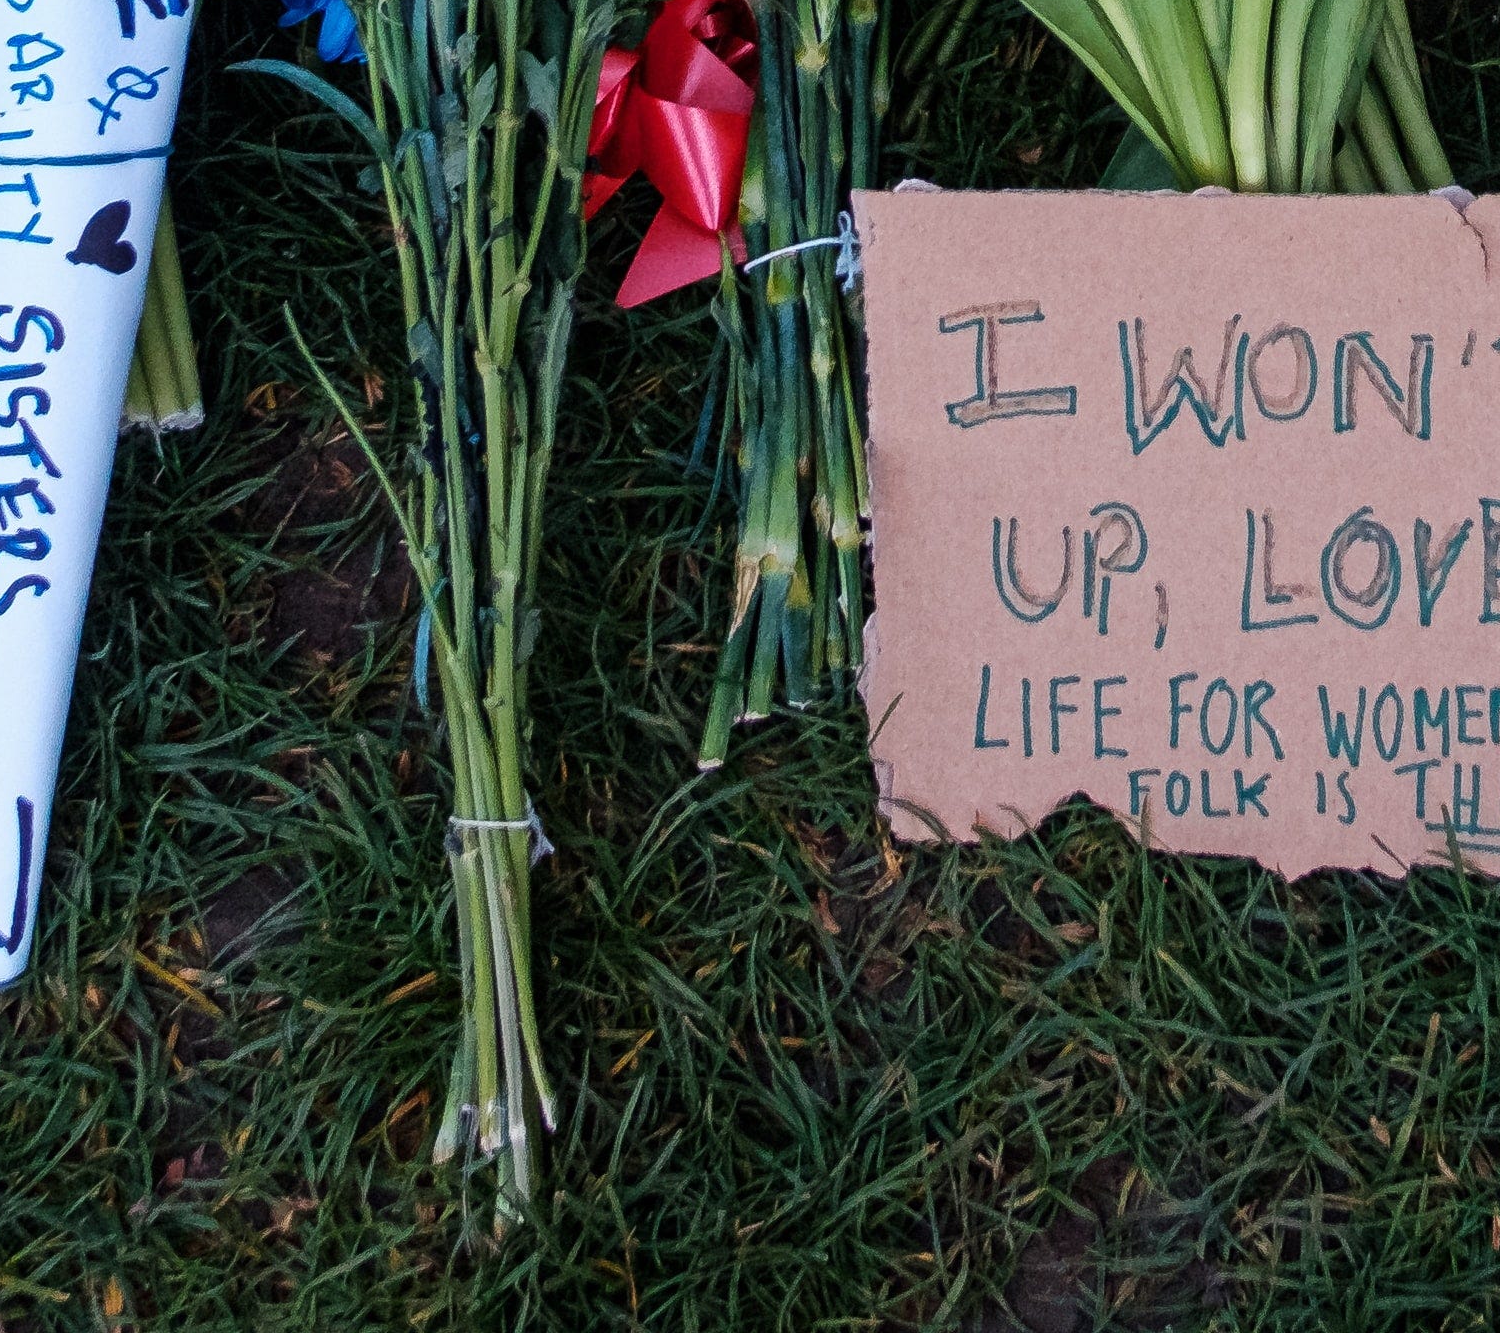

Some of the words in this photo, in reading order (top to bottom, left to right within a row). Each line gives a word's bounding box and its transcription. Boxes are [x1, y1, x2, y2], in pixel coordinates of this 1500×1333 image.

[938, 298, 1077, 428] I
[992, 503, 1171, 649] UP,
[974, 662, 1129, 760] LIFE
[1167, 671, 1286, 762] FOR
[1126, 767, 1273, 819] FOLK
[1315, 769, 1358, 826] IS
